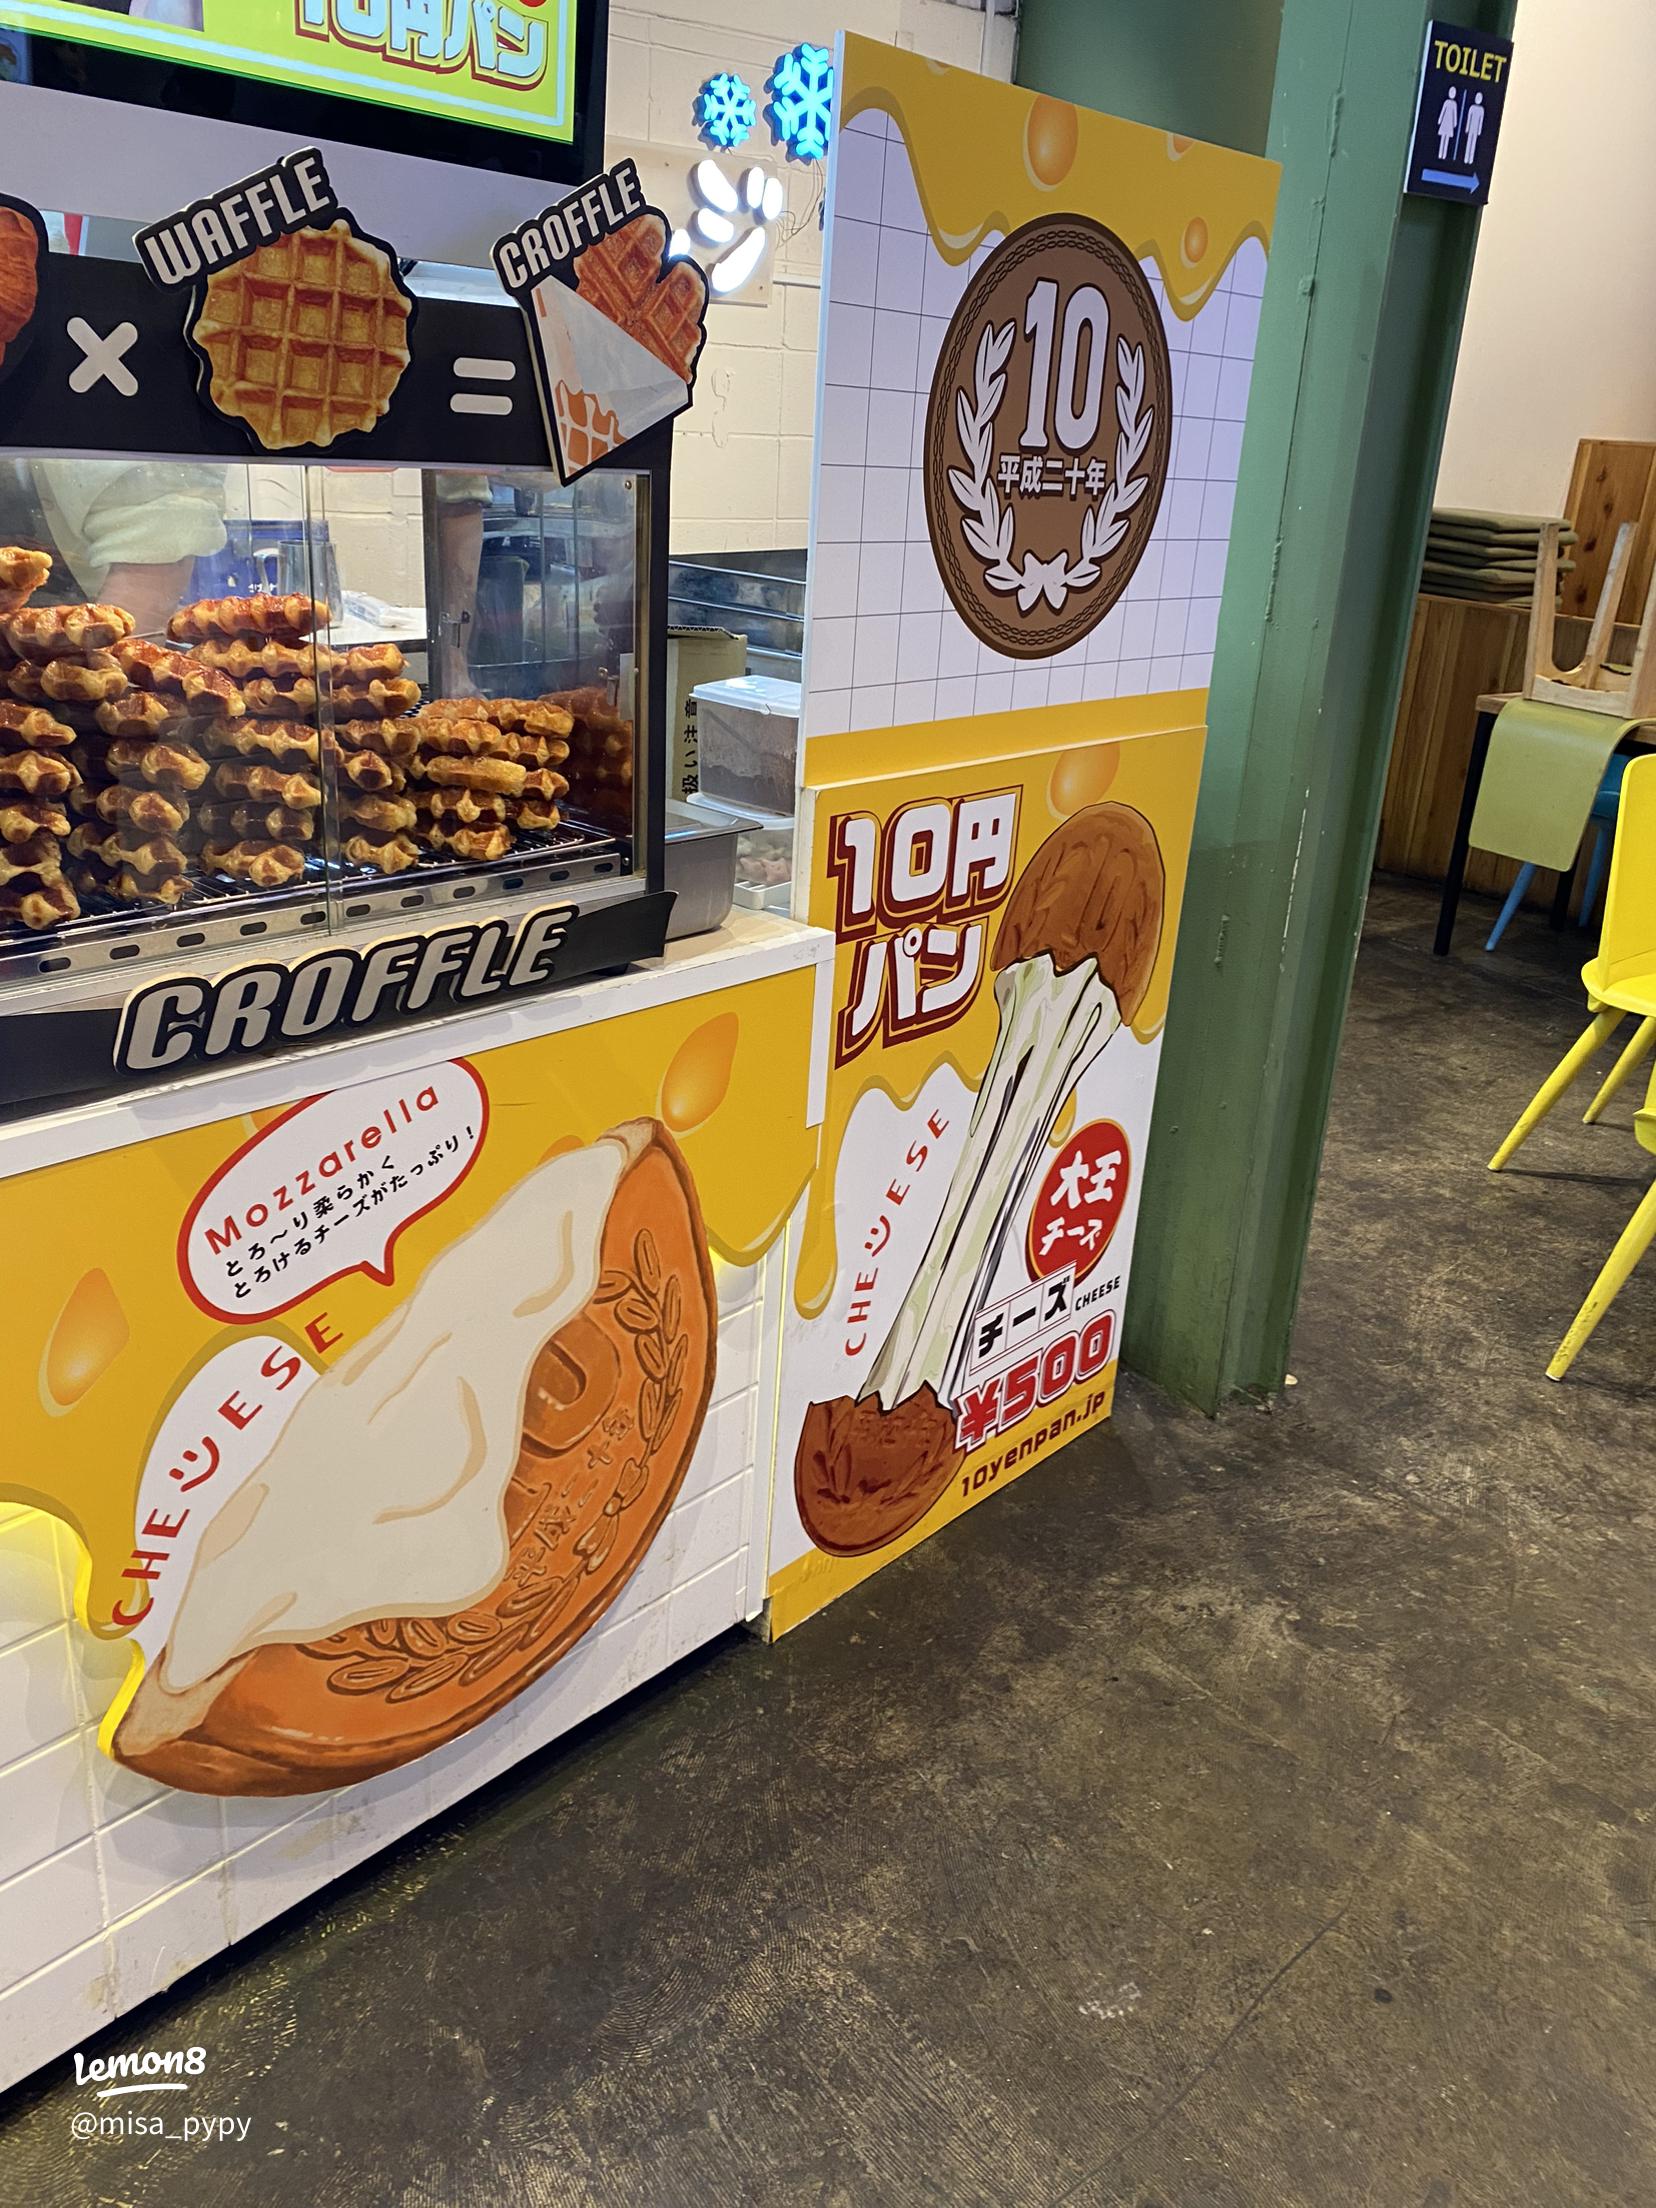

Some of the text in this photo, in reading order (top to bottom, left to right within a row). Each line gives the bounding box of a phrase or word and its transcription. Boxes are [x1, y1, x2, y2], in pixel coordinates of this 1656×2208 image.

[298, 0, 546, 86] 円パン
[1434, 40, 1507, 83] TOILET
[144, 157, 330, 285] WAFFLE
[499, 166, 644, 289] CROFFLE
[1019, 279, 1110, 450] 10
[998, 454, 1107, 497] 平成二十年
[834, 788, 1021, 930] 10円
[126, 910, 574, 1071] CROFFLE
[843, 919, 986, 1052] パン
[204, 1086, 439, 1255] Mozzarella
[1051, 1150, 1122, 1210] 大王
[957, 1311, 1114, 1447] ¥500
[978, 1275, 1121, 1358] チーズ CHEESE
[962, 1392, 1105, 1497] 10yenpan.jp
